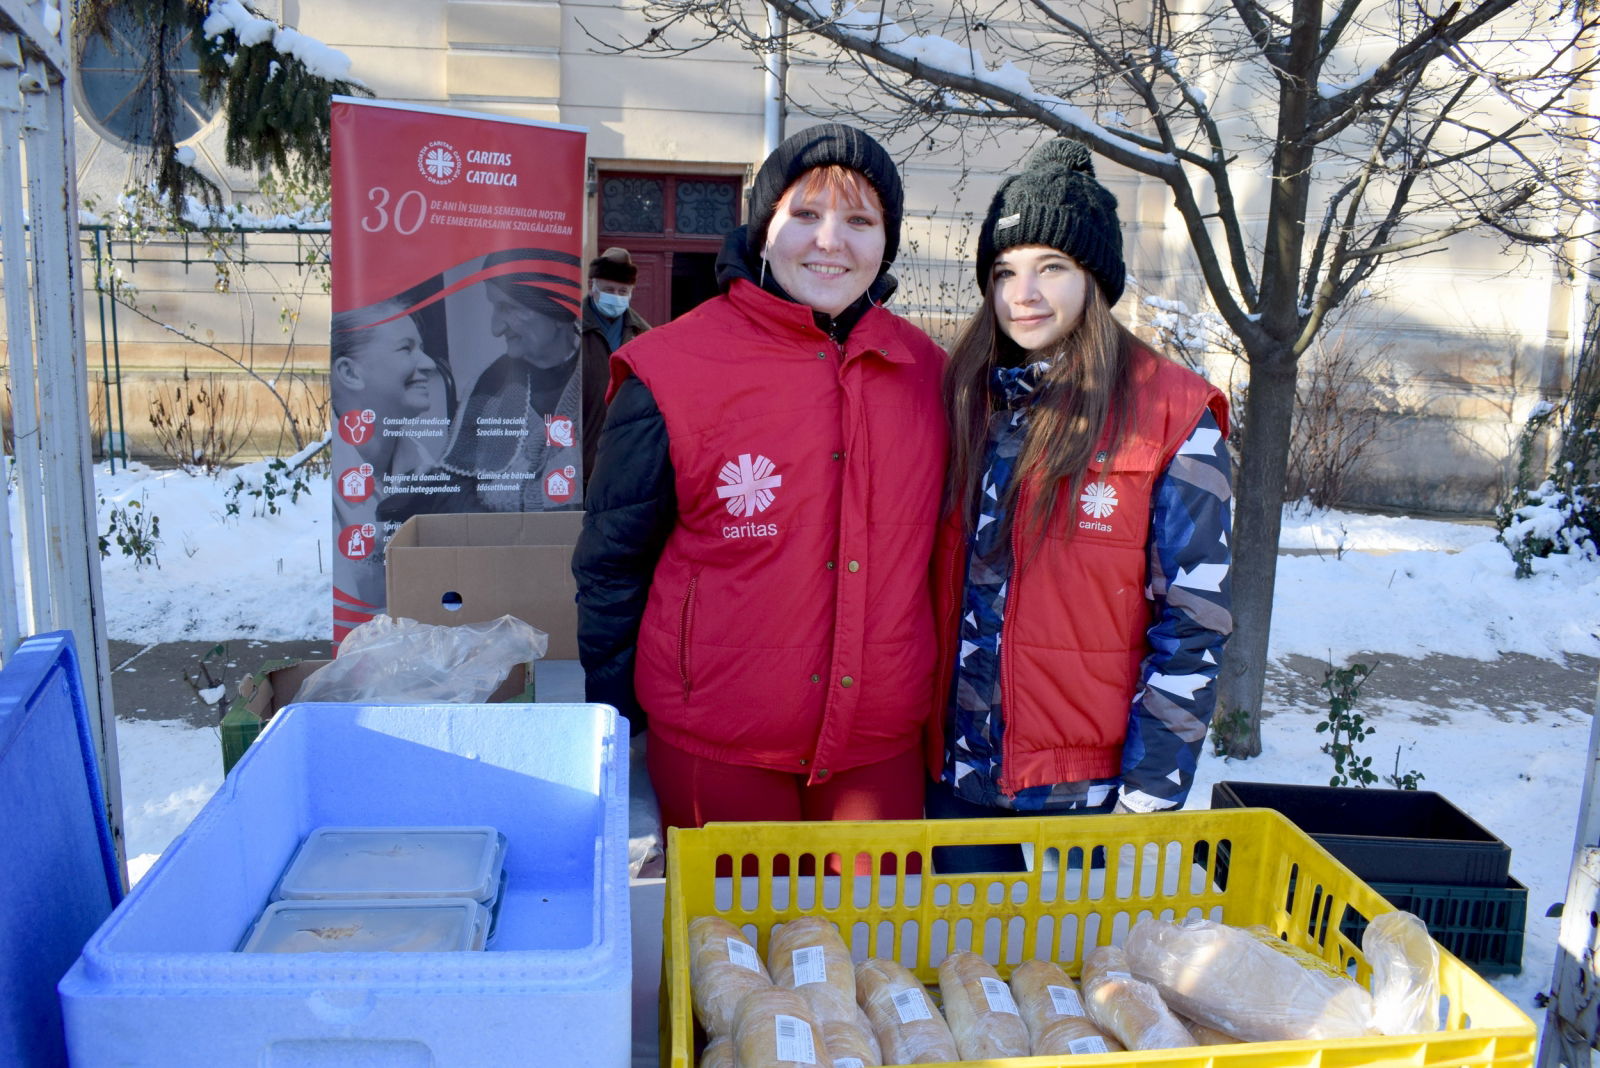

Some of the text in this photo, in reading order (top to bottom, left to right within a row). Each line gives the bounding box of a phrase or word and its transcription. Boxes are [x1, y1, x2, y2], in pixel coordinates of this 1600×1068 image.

[466, 149, 512, 166] CARITAS
[466, 170, 517, 187] CATOLICA
[361, 186, 428, 236] 30
[430, 200, 442, 210] DE
[442, 201, 457, 211] ANI
[458, 201, 467, 212] ÎN
[494, 206, 537, 218] SEMENILOR
[430, 214, 573, 235] ÉVE EMBERTÁRSAINK SZOLGÁLATÁBAN
[420, 417, 451, 426] medicale
[383, 429, 404, 437] Orvosi
[504, 428, 529, 438] konyha
[411, 473, 418, 481] la
[419, 472, 451, 481] domiciliu
[502, 471, 510, 480] de
[383, 485, 461, 495] Otthoni beteggondozás
[722, 522, 778, 538] caritas
[1079, 521, 1112, 532] caritas
